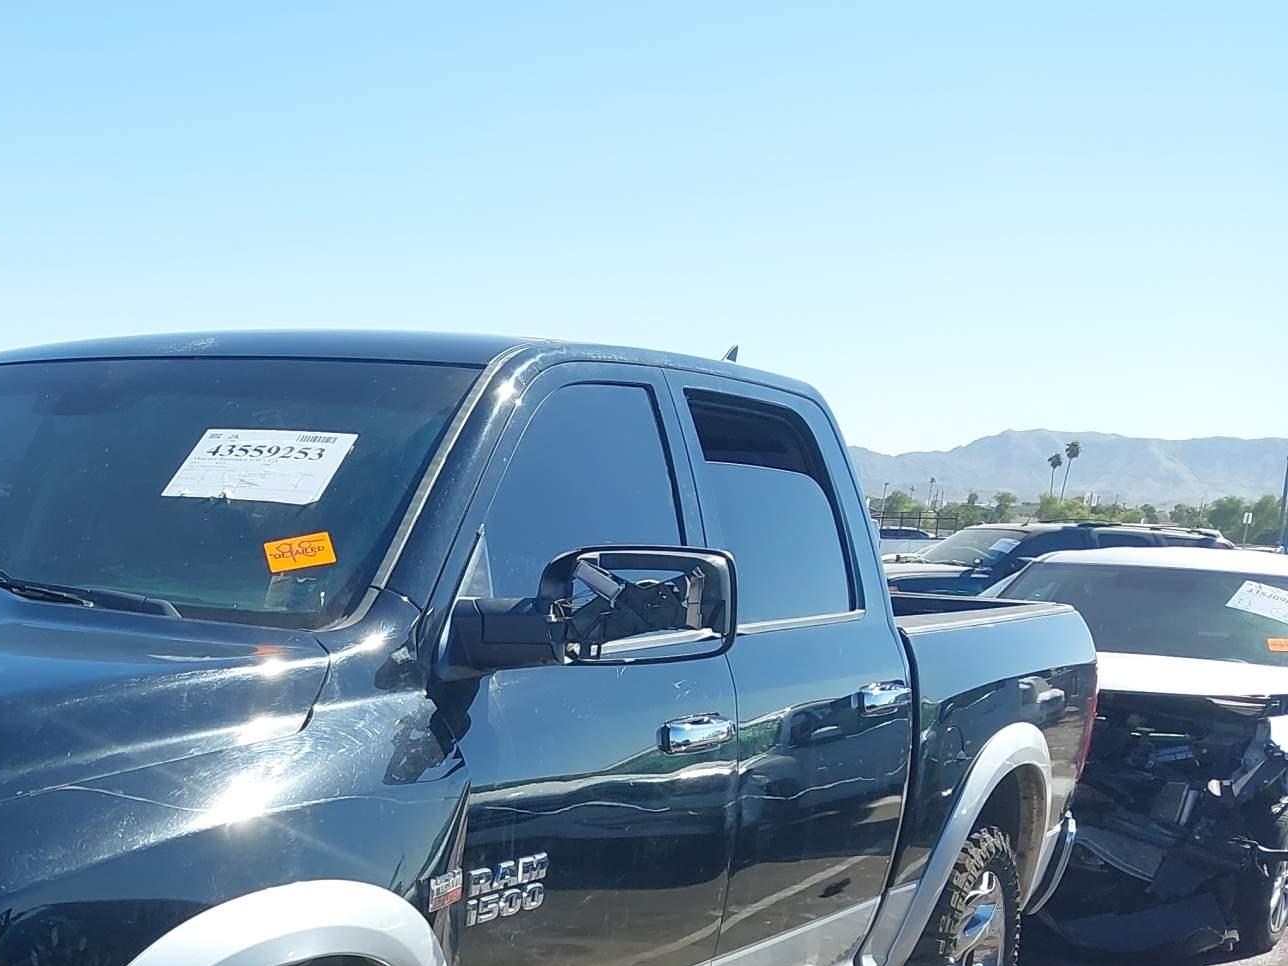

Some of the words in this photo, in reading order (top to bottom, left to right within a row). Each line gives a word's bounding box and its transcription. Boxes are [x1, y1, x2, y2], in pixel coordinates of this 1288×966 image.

[207, 444, 326, 461] 43559253
[468, 852, 548, 897] RAM
[466, 883, 544, 927] 1500
